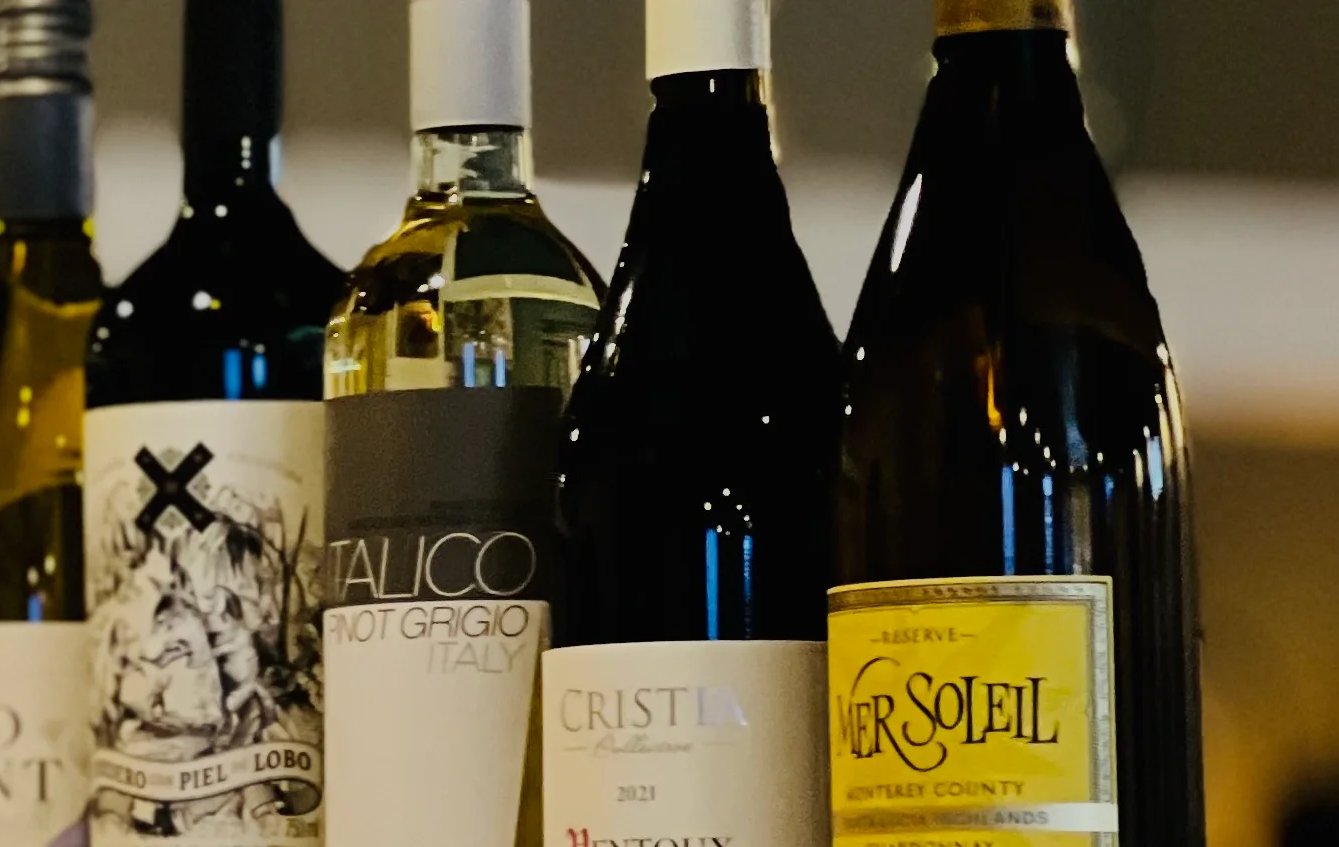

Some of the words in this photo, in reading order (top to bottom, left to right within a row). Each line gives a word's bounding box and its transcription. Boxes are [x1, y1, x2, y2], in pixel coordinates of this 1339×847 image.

[325, 531, 536, 600] TALICO
[400, 604, 529, 640] GRIGIO
[881, 626, 959, 645] RESERVE
[425, 641, 526, 674] ITALY
[902, 671, 1061, 746] SOLEIL
[179, 764, 228, 790] PIEL
[254, 749, 312, 773] LOBO
[616, 784, 656, 802] 2021
[932, 780, 1025, 798] COUNTY
